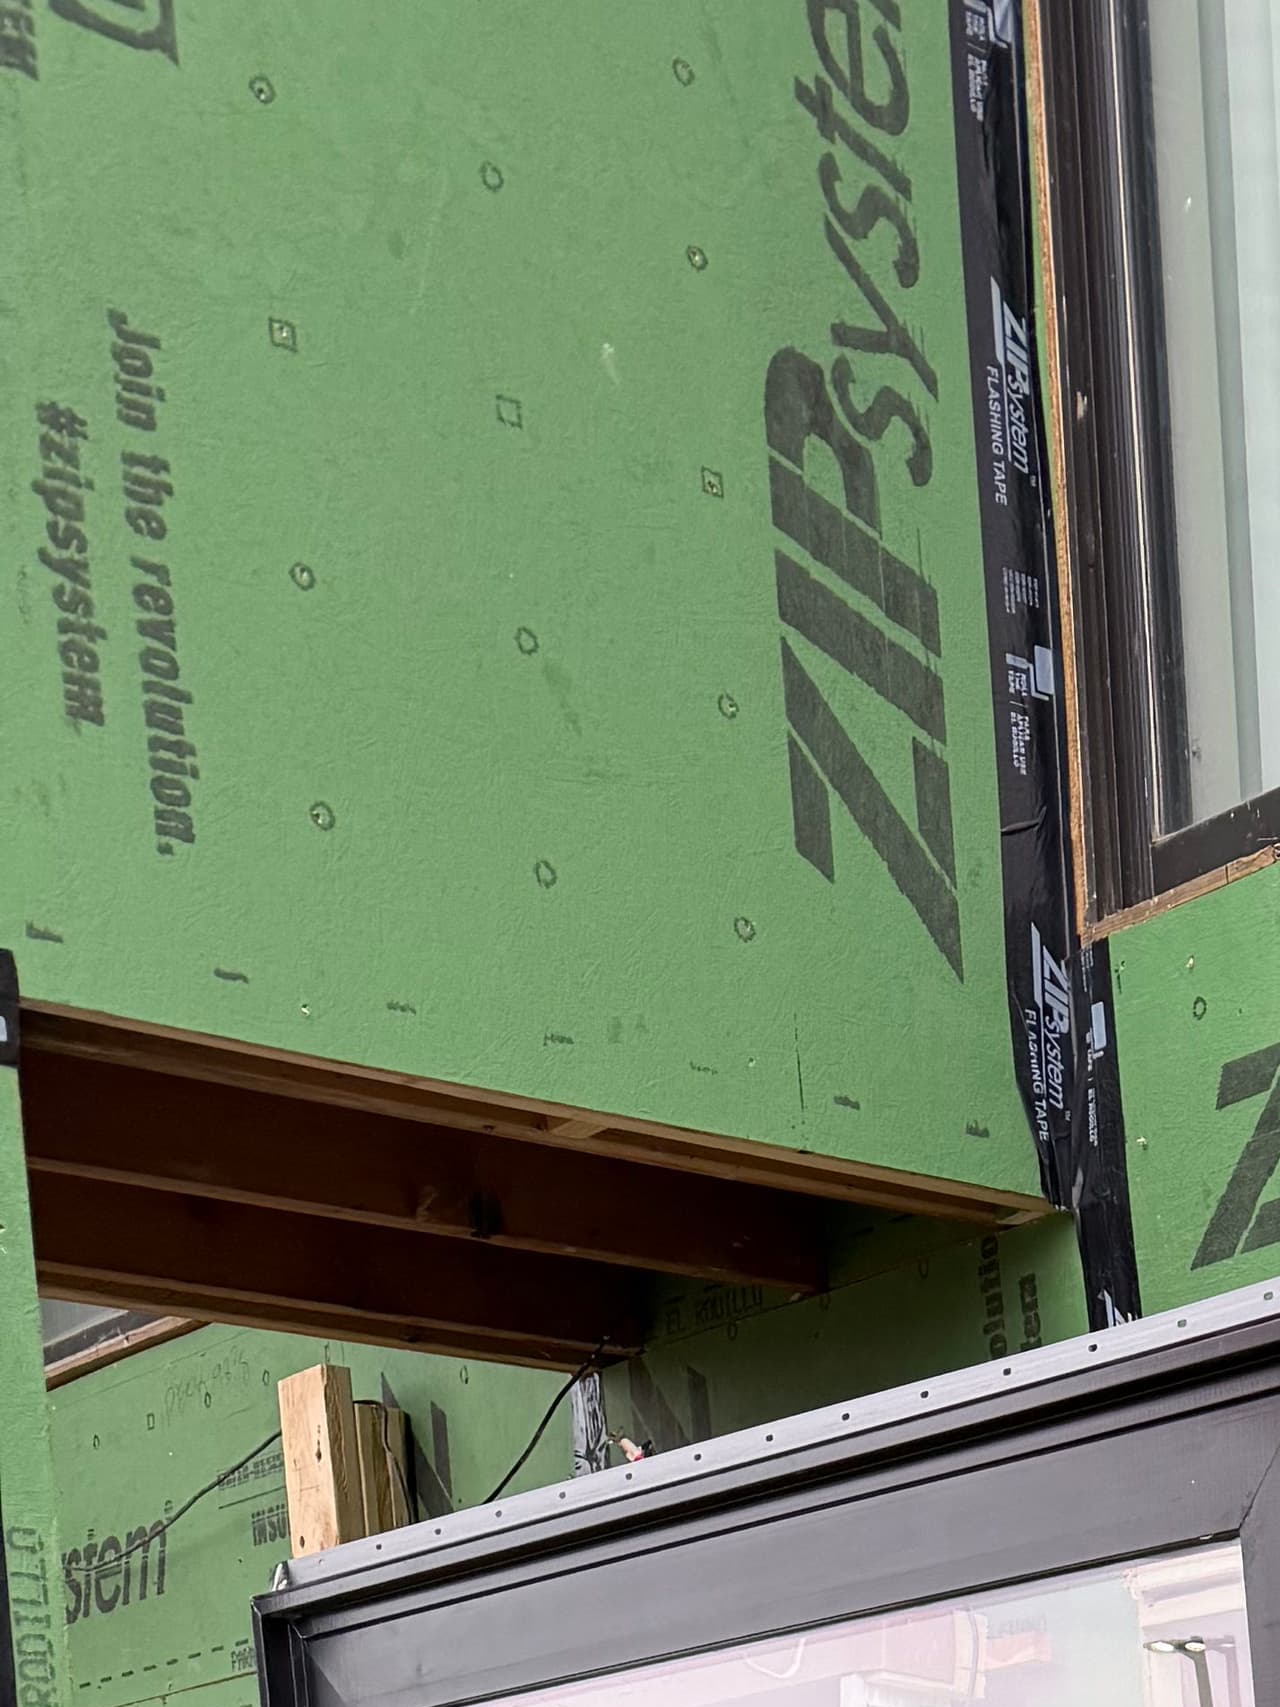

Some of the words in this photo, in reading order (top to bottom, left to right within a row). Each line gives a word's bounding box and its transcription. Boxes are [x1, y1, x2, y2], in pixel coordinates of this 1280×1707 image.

[107, 309, 163, 433] Join
[120, 446, 175, 542] the
[765, 0, 964, 983] ZIPsyste
[32, 400, 106, 731] #zipsystem
[132, 554, 203, 859] revolution.
